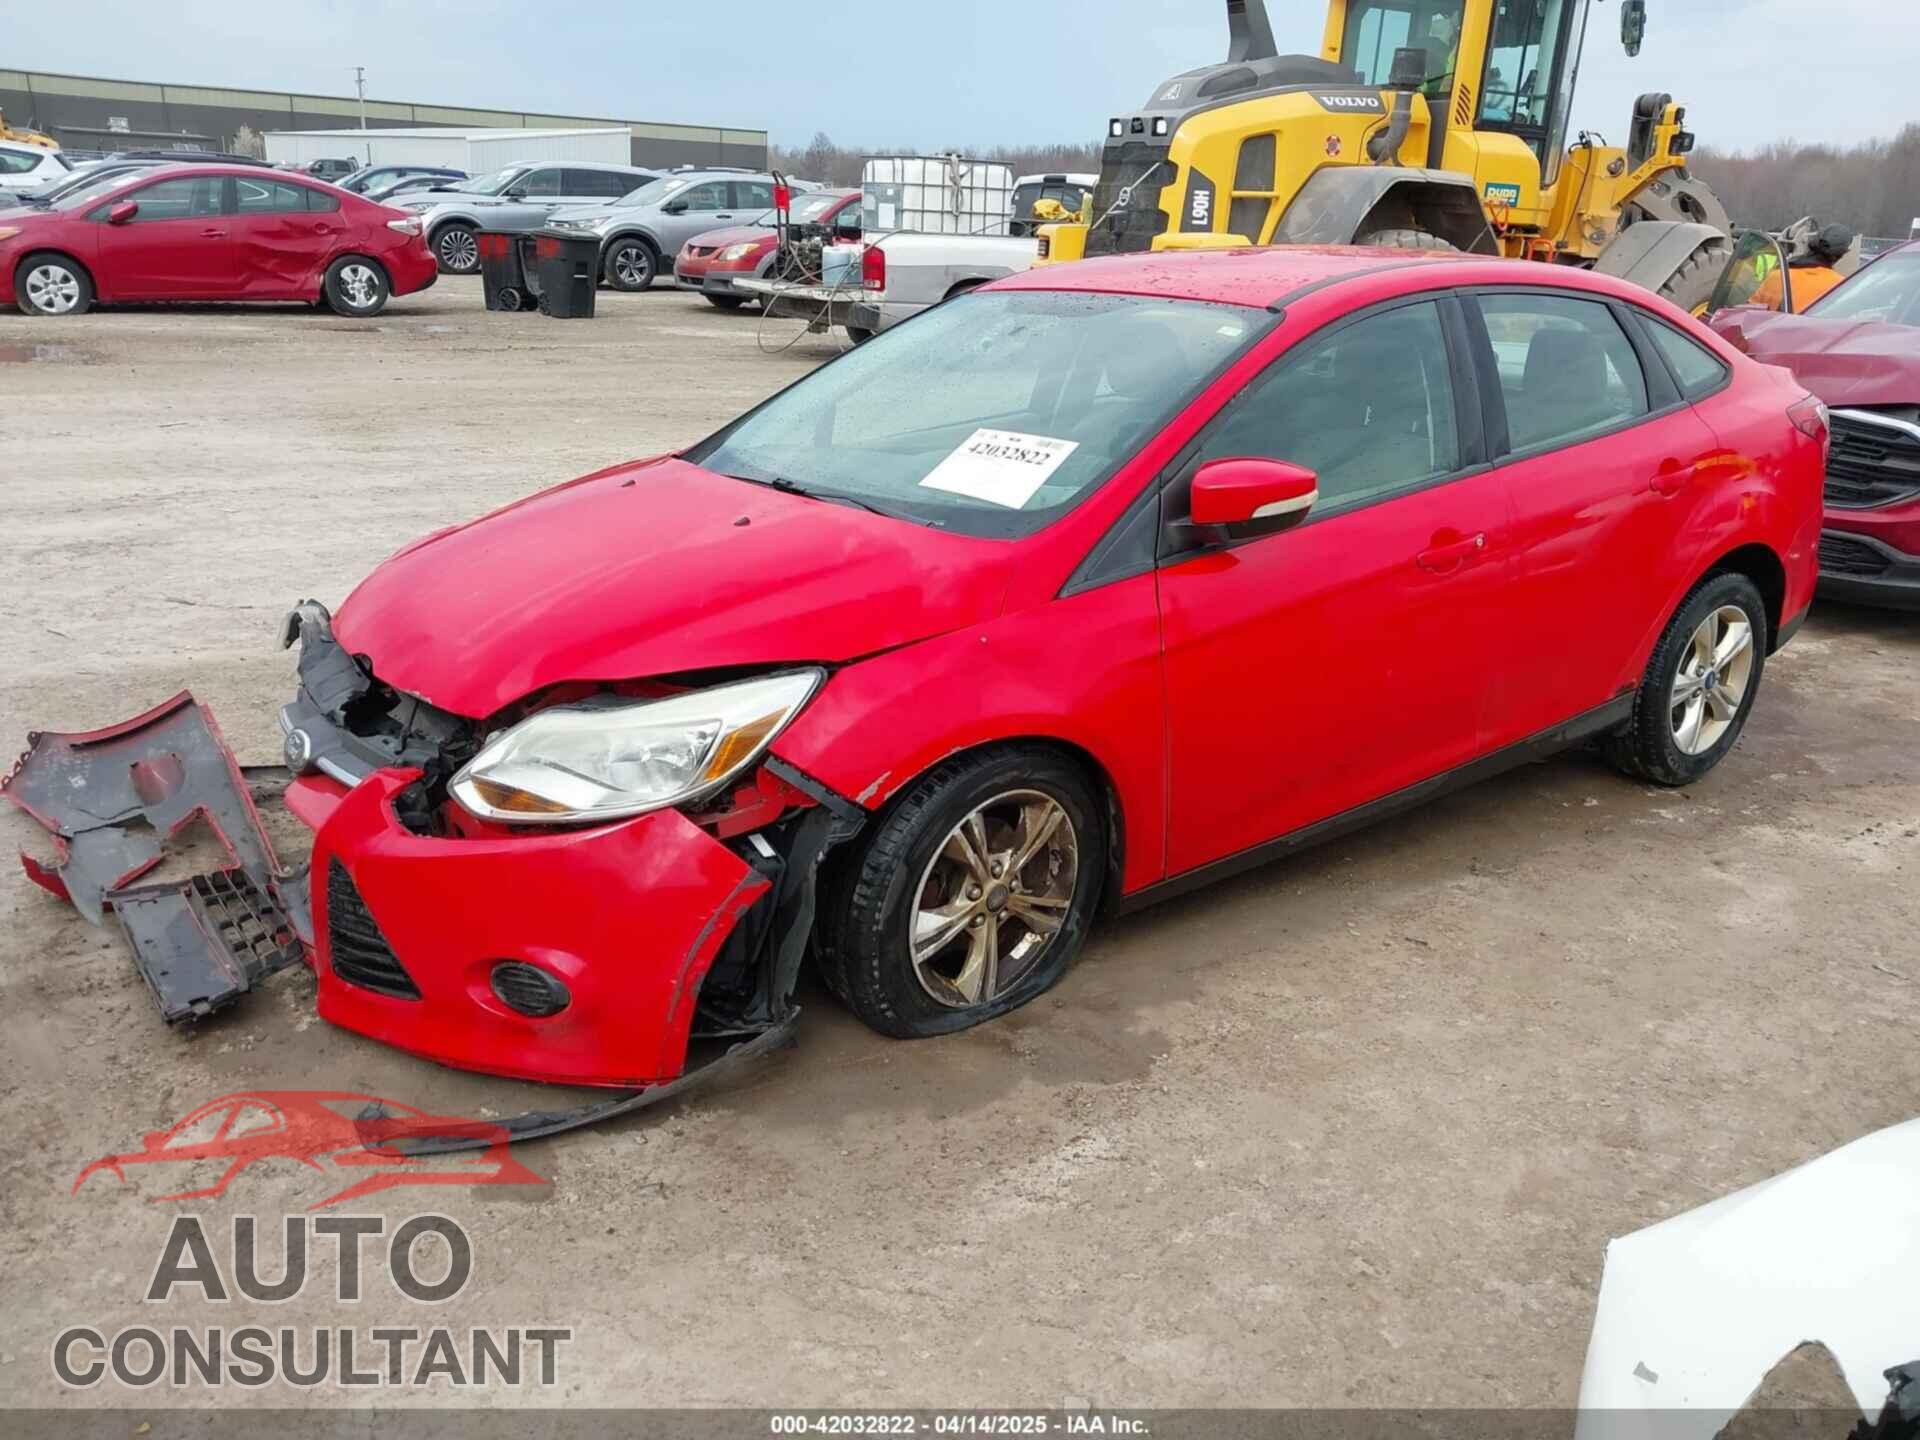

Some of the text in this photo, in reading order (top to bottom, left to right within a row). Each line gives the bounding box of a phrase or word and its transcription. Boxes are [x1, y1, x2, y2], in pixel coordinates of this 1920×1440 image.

[1320, 96, 1379, 107] VOLVO
[1192, 190, 1209, 225] L90H
[968, 442, 1051, 465] 42032822
